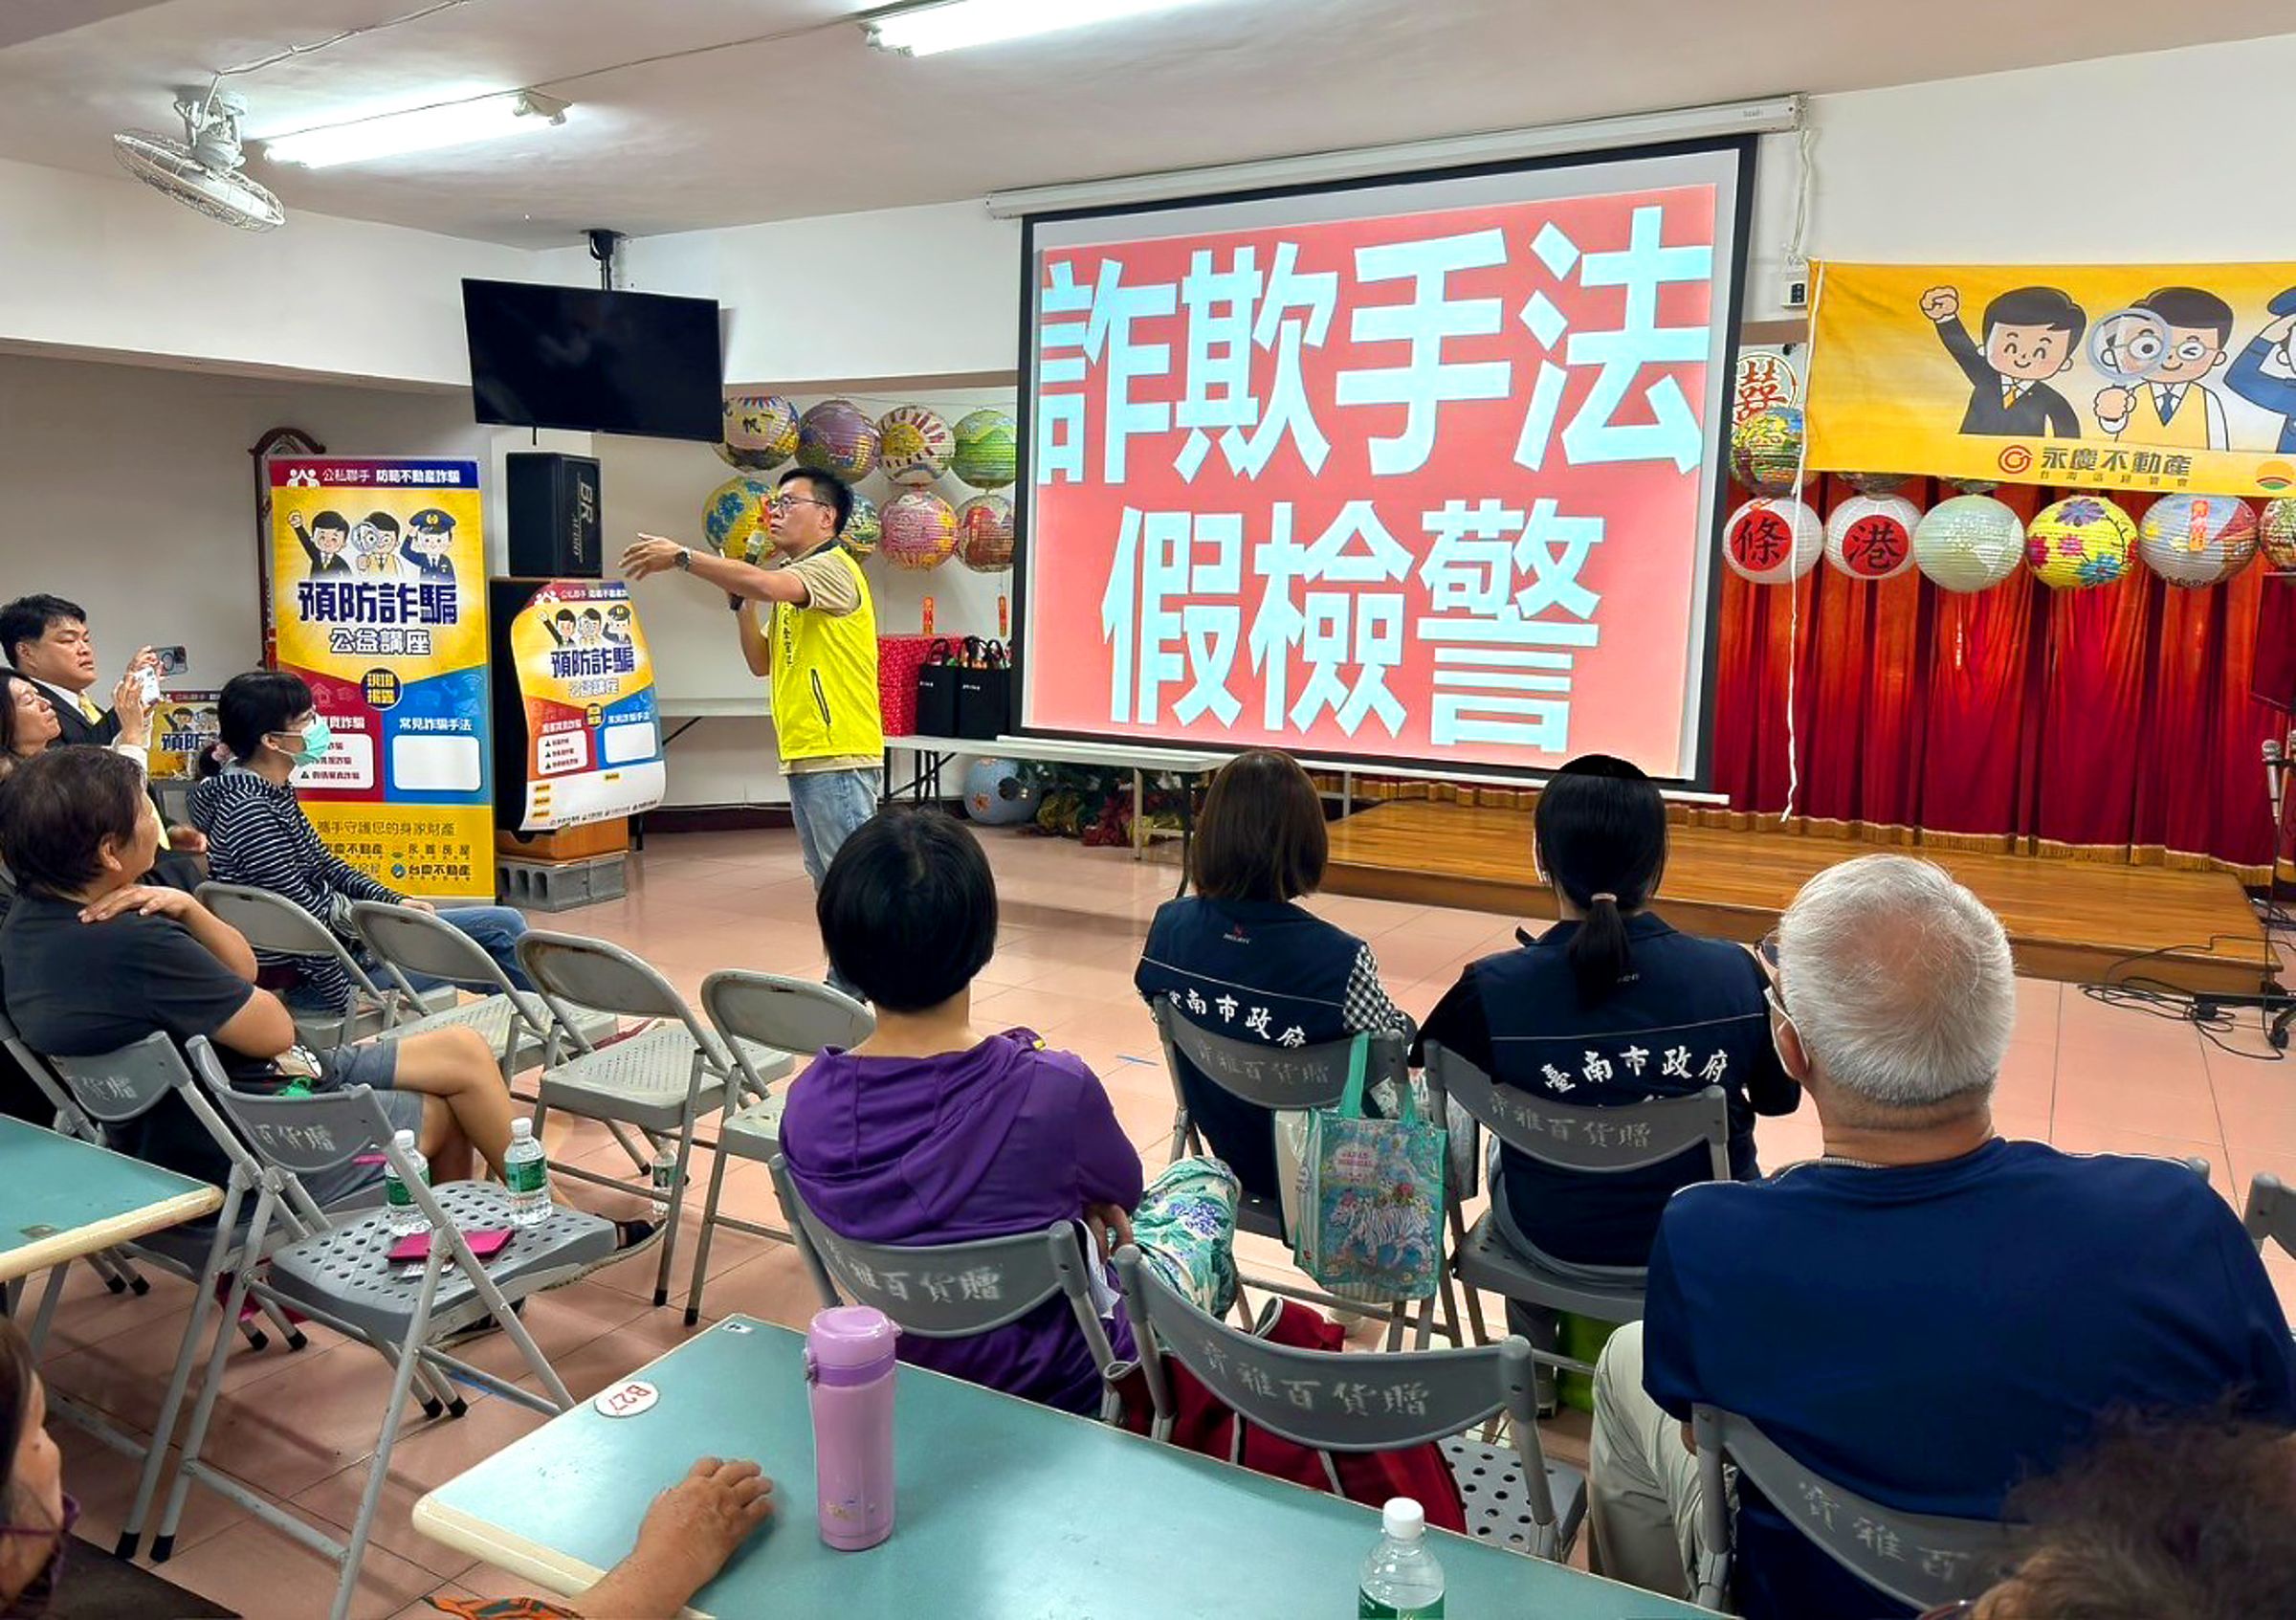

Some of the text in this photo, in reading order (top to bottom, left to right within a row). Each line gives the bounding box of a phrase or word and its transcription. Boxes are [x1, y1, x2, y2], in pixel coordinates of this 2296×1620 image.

[1038, 206, 1713, 484] 詐欺手法
[322, 469, 460, 483] 公私聯手 防範不動產詐騙
[2041, 446, 2193, 476] 永慶不動產
[1733, 517, 1899, 569] 條 港
[297, 582, 457, 625] 預防詐騙
[329, 628, 431, 655] 公益講座
[1102, 499, 1604, 753] 假檢警
[550, 646, 634, 678] 預防詐騙
[399, 717, 473, 731] 常見詐騙手法
[1168, 988, 1307, 1049] 臺南市政府
[1540, 1044, 1729, 1094] 臺南市政府
[608, 1384, 651, 1411] B27
